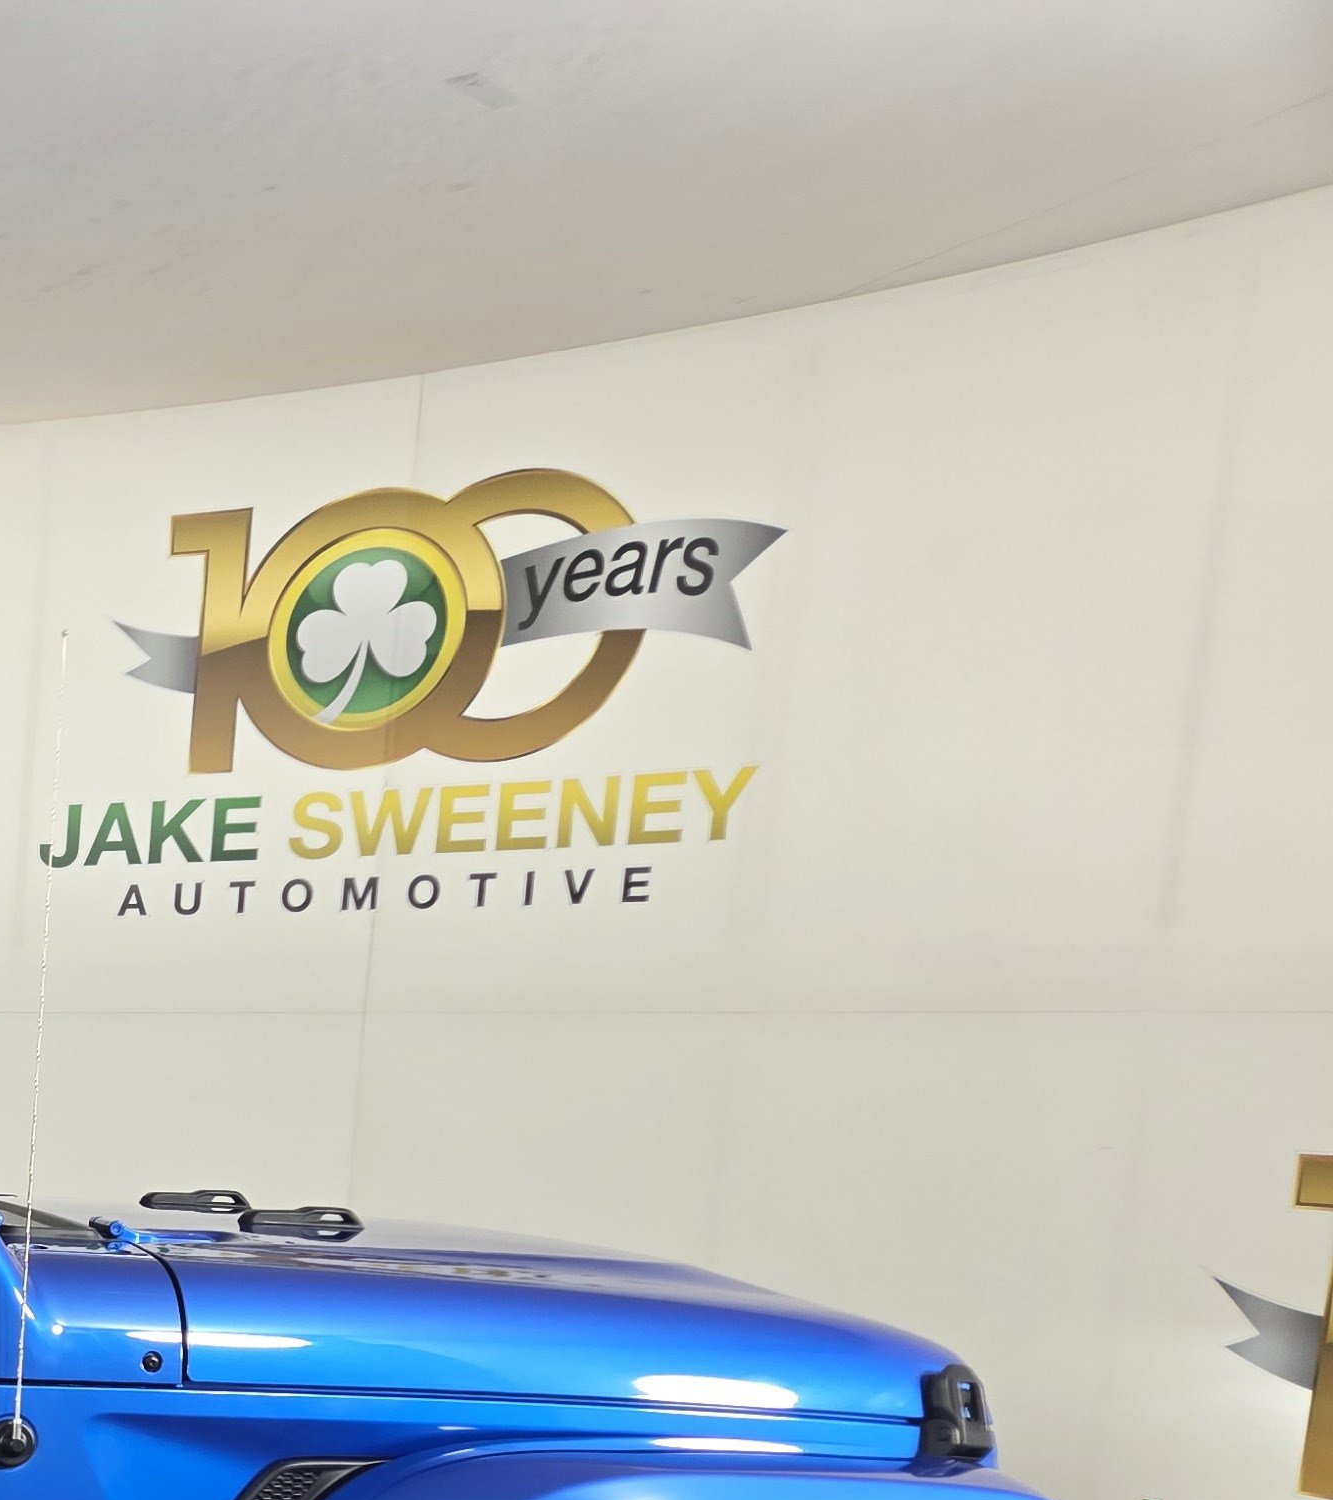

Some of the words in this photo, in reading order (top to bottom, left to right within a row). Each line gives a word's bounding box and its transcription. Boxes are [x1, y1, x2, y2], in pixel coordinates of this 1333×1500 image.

[169, 468, 647, 775] 100
[516, 531, 720, 630] years
[39, 795, 264, 870] JAKE
[288, 765, 760, 861] SWEENEY
[116, 866, 653, 917] AUTOMOTIVE
